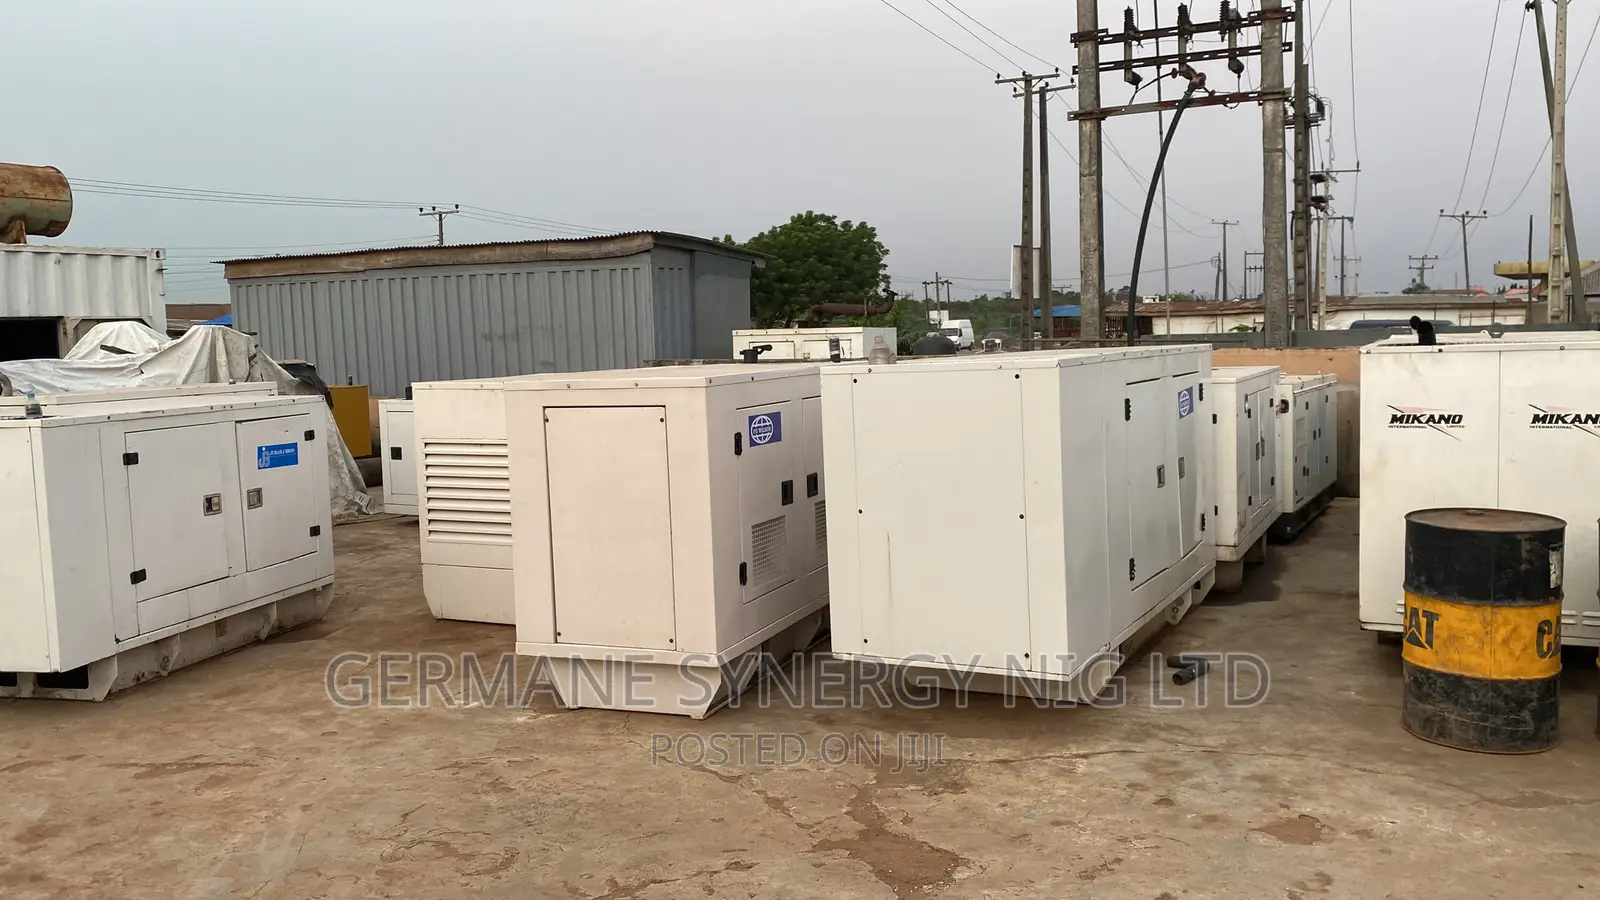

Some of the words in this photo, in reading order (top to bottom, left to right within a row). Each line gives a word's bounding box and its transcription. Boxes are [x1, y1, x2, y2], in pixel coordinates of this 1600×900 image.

[1389, 413, 1464, 425] MIKANO
[1530, 413, 1600, 425] MIKAN
[1404, 606, 1440, 650] AT
